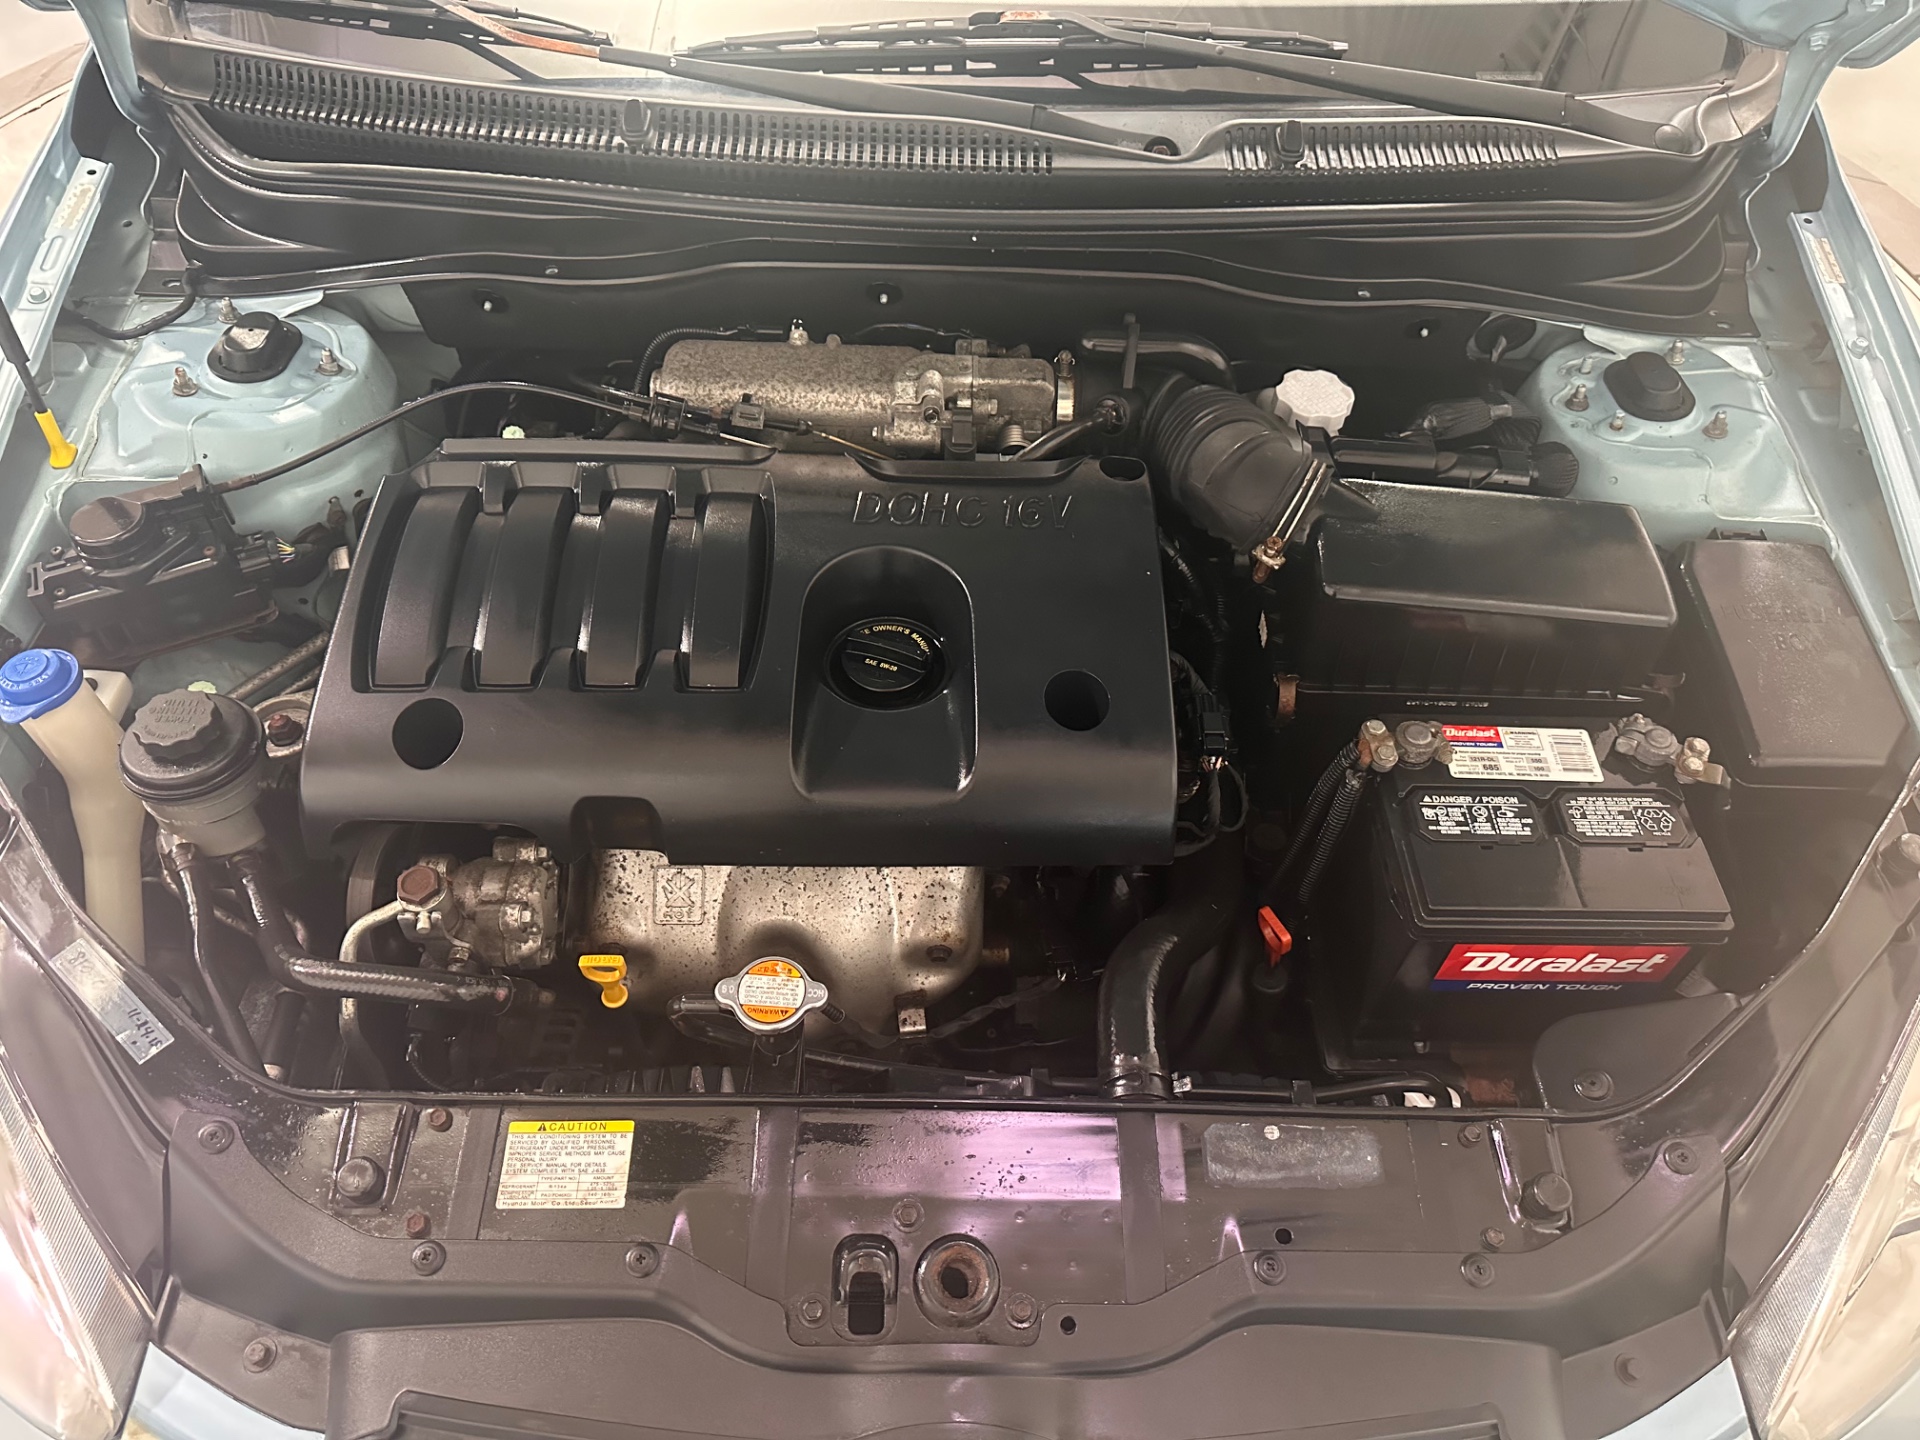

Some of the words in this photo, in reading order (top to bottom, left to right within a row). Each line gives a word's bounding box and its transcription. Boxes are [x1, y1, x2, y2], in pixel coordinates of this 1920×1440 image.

[852, 490, 988, 527] DOHC
[1002, 493, 1073, 529] 16V
[872, 625, 911, 635] OWNER'S
[864, 658, 878, 667] SAE
[1444, 727, 1497, 738] Duralast
[1460, 950, 1667, 974] Duralast
[1466, 983, 1550, 991] PROVEN
[1556, 984, 1622, 992] TOUGH
[807, 988, 825, 998] HCC
[747, 1007, 780, 1016] WARNING
[549, 1121, 607, 1132] CAUTION
